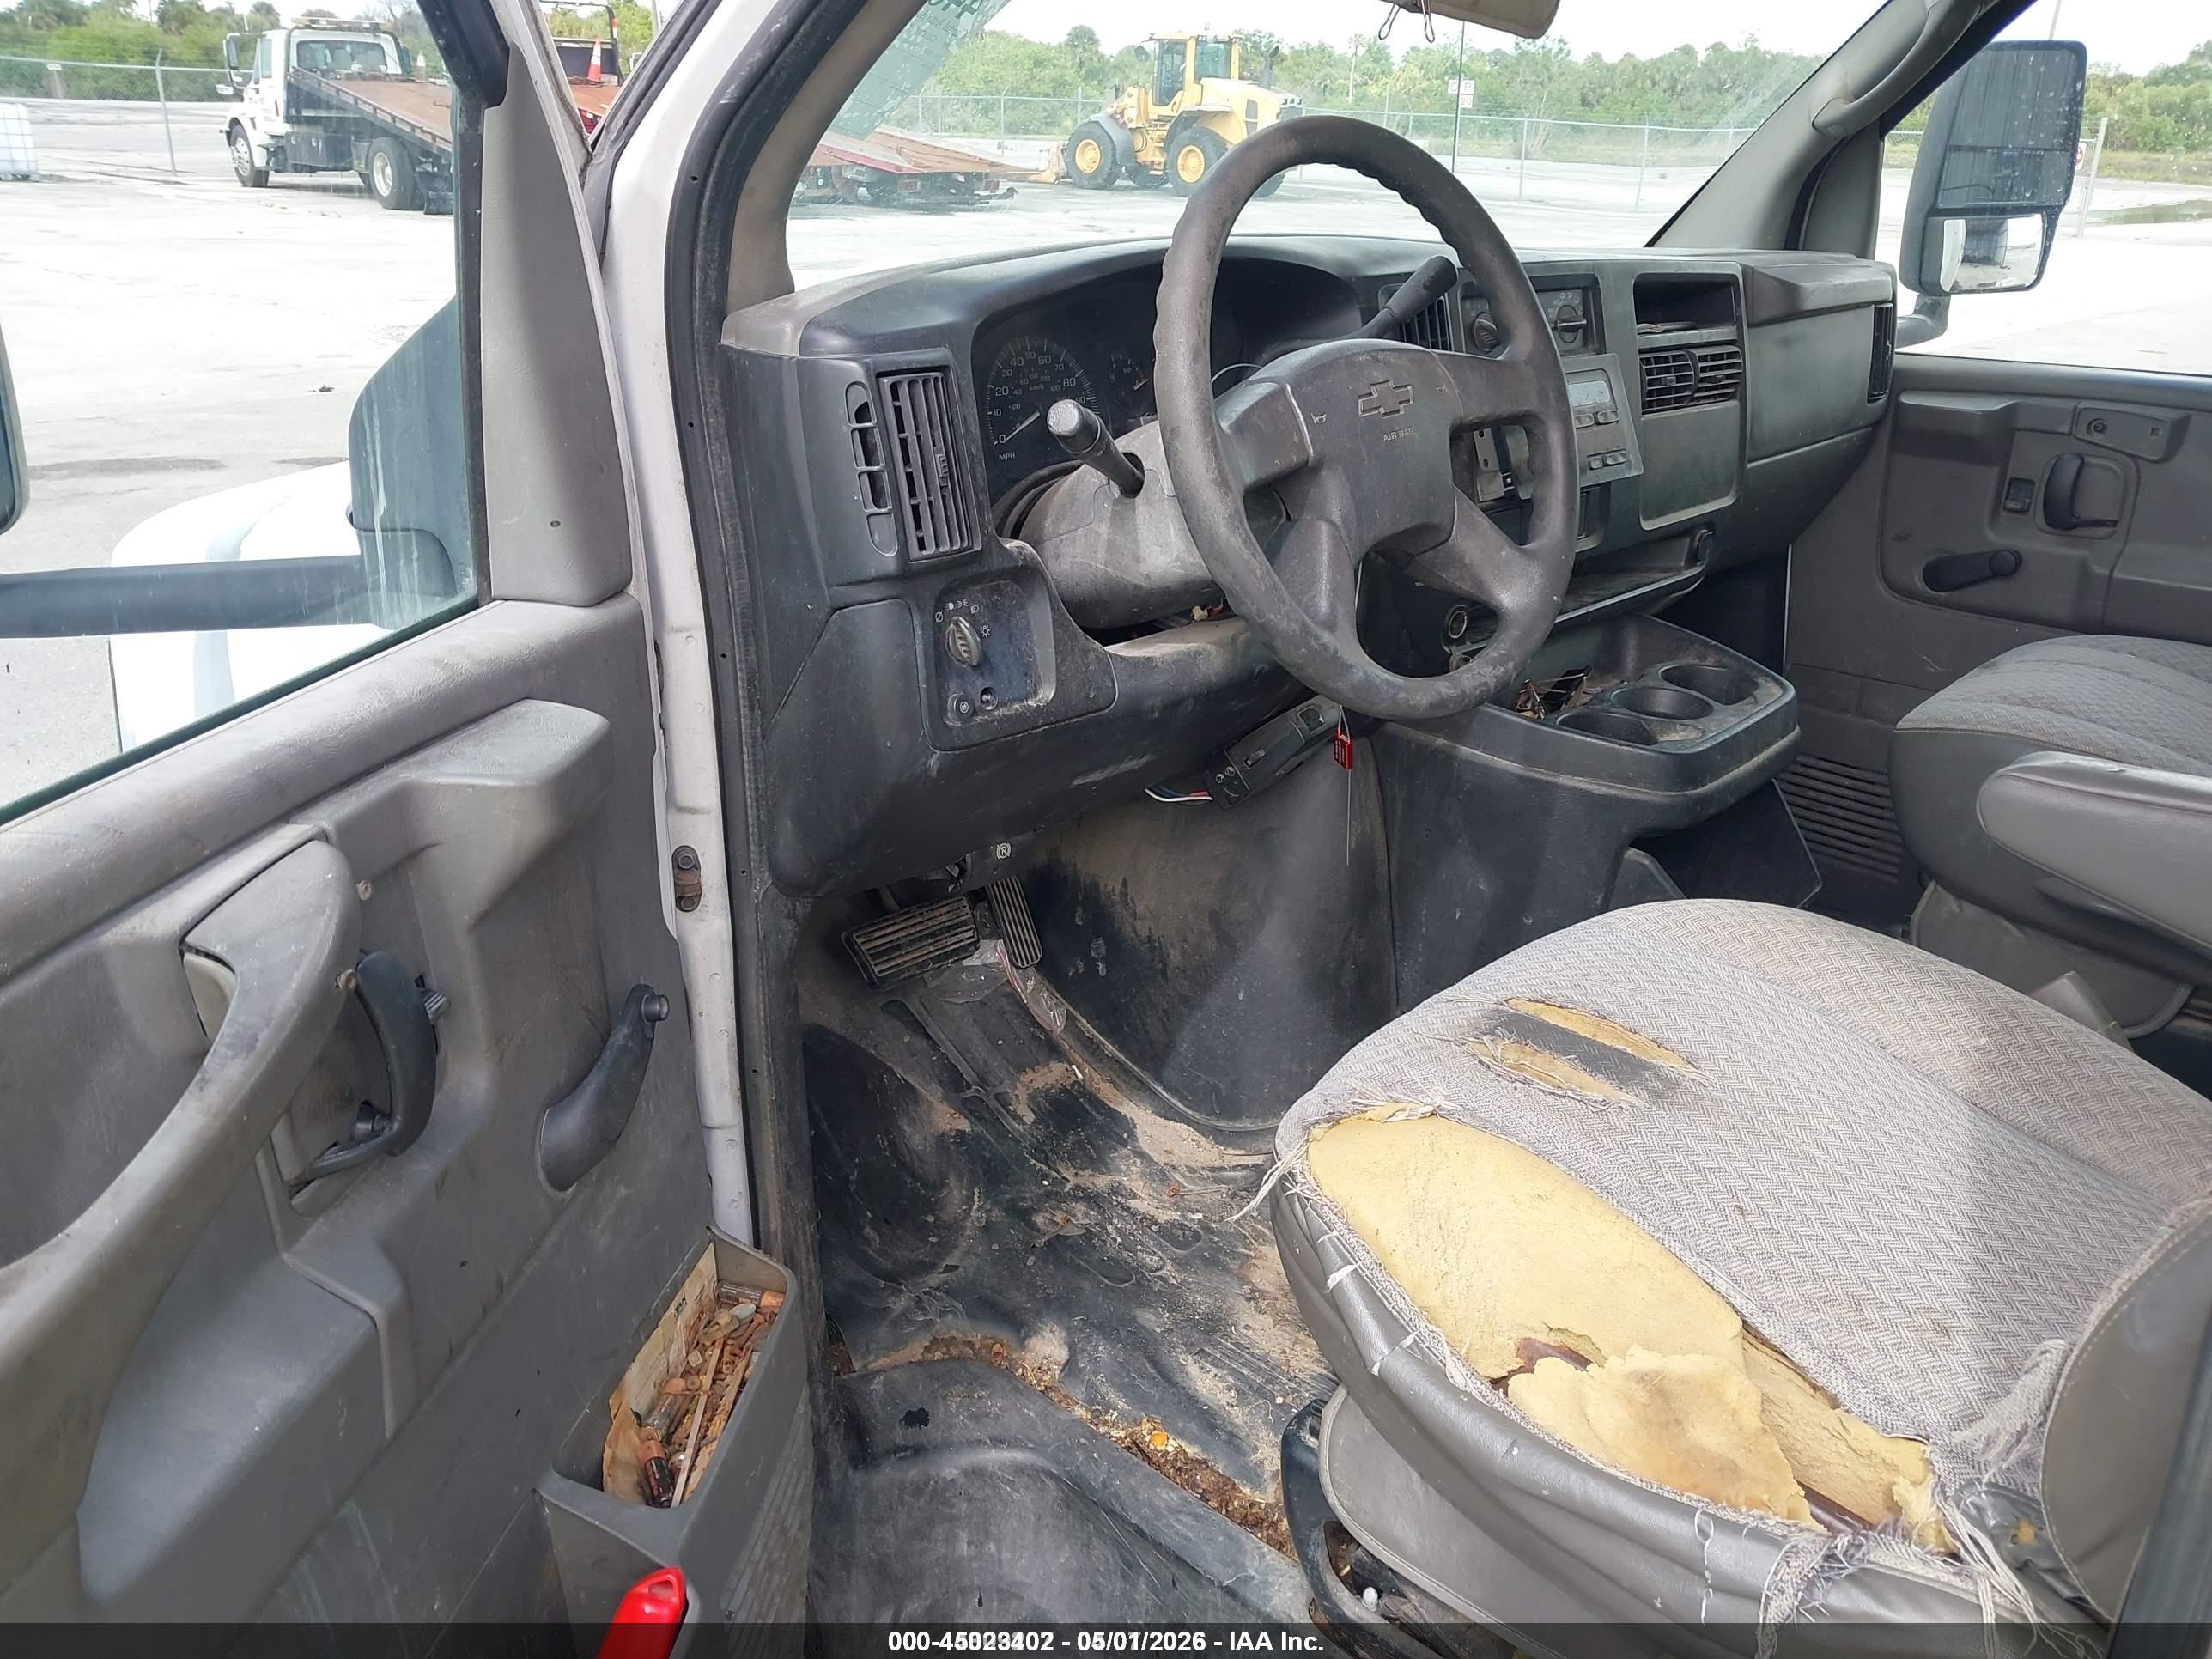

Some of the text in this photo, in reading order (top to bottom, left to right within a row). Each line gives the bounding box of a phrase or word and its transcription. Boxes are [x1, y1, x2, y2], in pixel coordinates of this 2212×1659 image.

[1010, 357, 1024, 366] 40
[1038, 356, 1051, 364] 60
[1063, 378, 1076, 386] 80
[995, 386, 1009, 396] 20
[999, 434, 1006, 443] 0
[1383, 431, 1397, 441] AIR
[999, 453, 1015, 461] MPH
